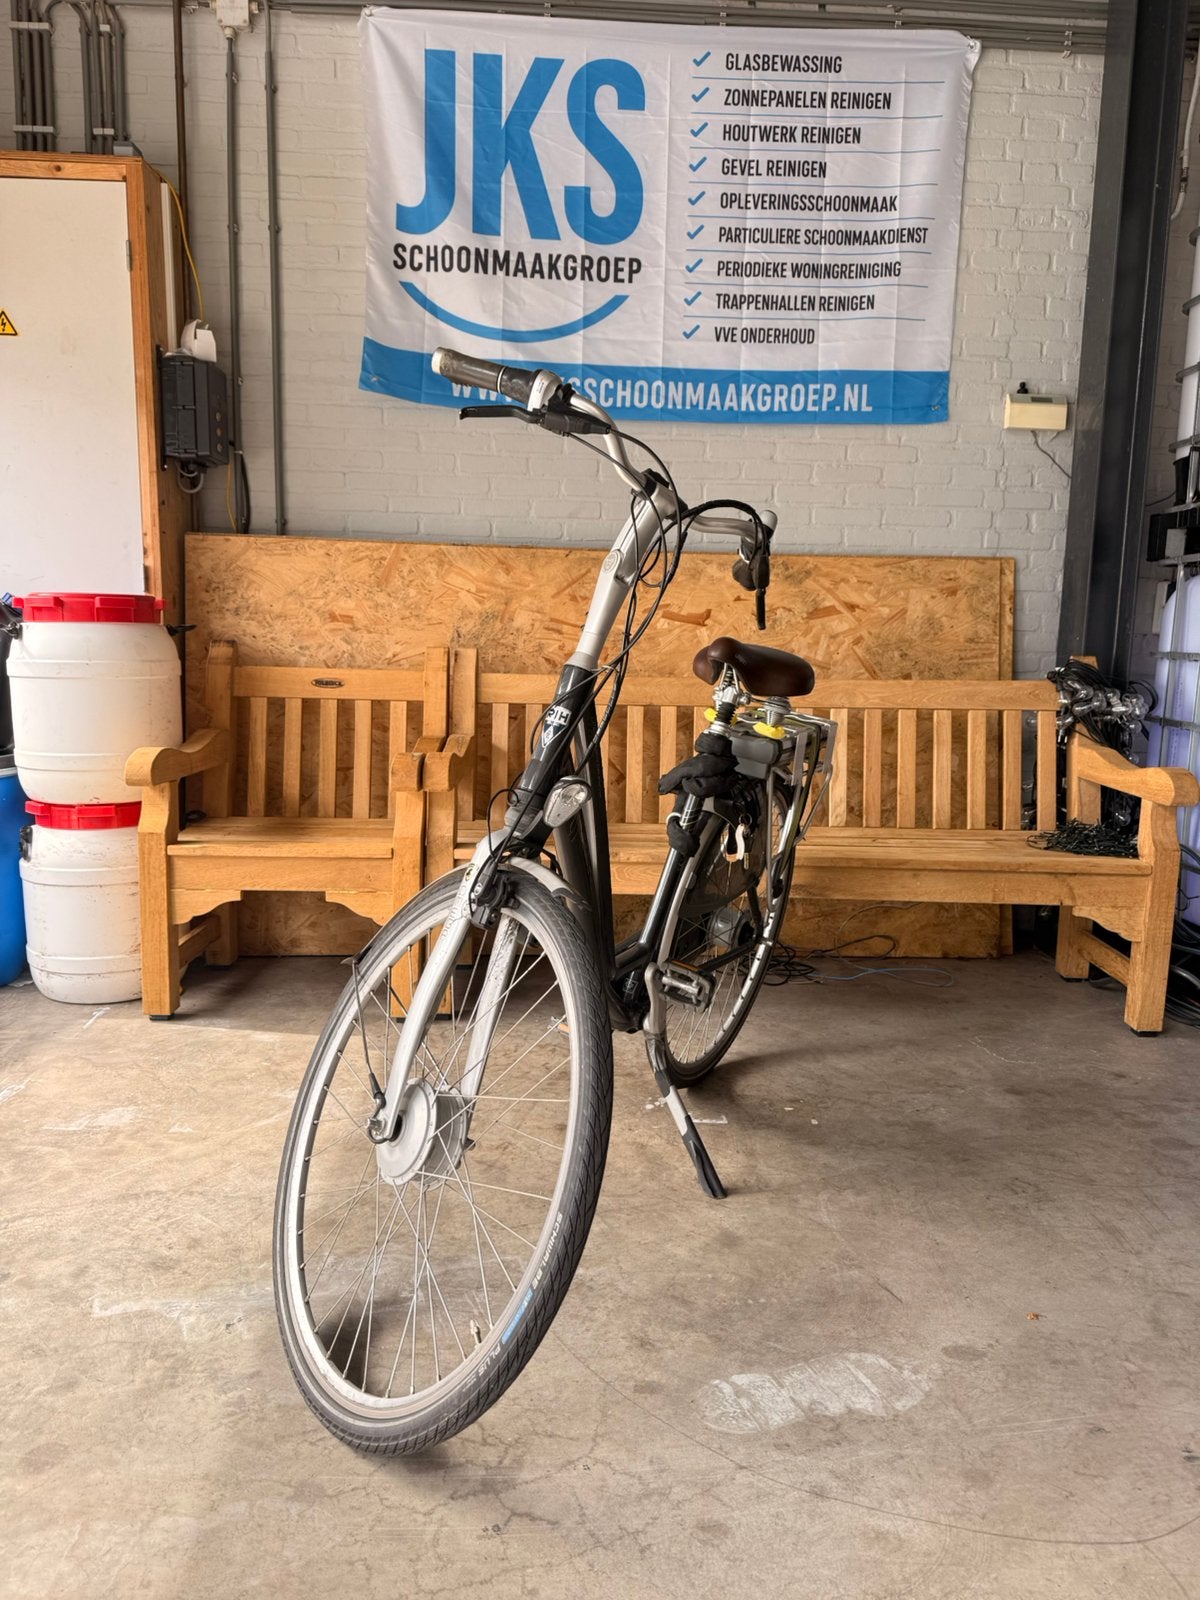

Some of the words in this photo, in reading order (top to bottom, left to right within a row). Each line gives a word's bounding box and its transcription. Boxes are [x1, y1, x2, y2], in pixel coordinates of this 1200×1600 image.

[725, 53, 843, 73] GLASBEWASSING
[724, 89, 827, 108] ZONNEPANELEN
[830, 92, 892, 110] REINIGEN
[722, 125, 798, 143] HOUTWERK
[801, 127, 861, 144] REINIGEN
[395, 48, 646, 245] JKS
[721, 159, 763, 177] GEVEL
[766, 160, 827, 178] REINIGEN
[720, 193, 898, 212] OPLEVERINGSSCHOONMAAK
[718, 227, 801, 244] PARTICULIERE
[804, 228, 929, 245] SCHOONMAAKDIENST
[393, 243, 642, 284] SCHOONMAAKGROEP
[717, 261, 788, 278] PERIODIEKE
[791, 261, 902, 279] WONINGREINIGING
[716, 294, 816, 311] TRAPPENHALLEN
[818, 295, 875, 311] REINIGEN
[715, 327, 738, 343] VVE
[740, 328, 815, 344] ONDERHOUD
[478, 1342, 501, 1377] PLUS
